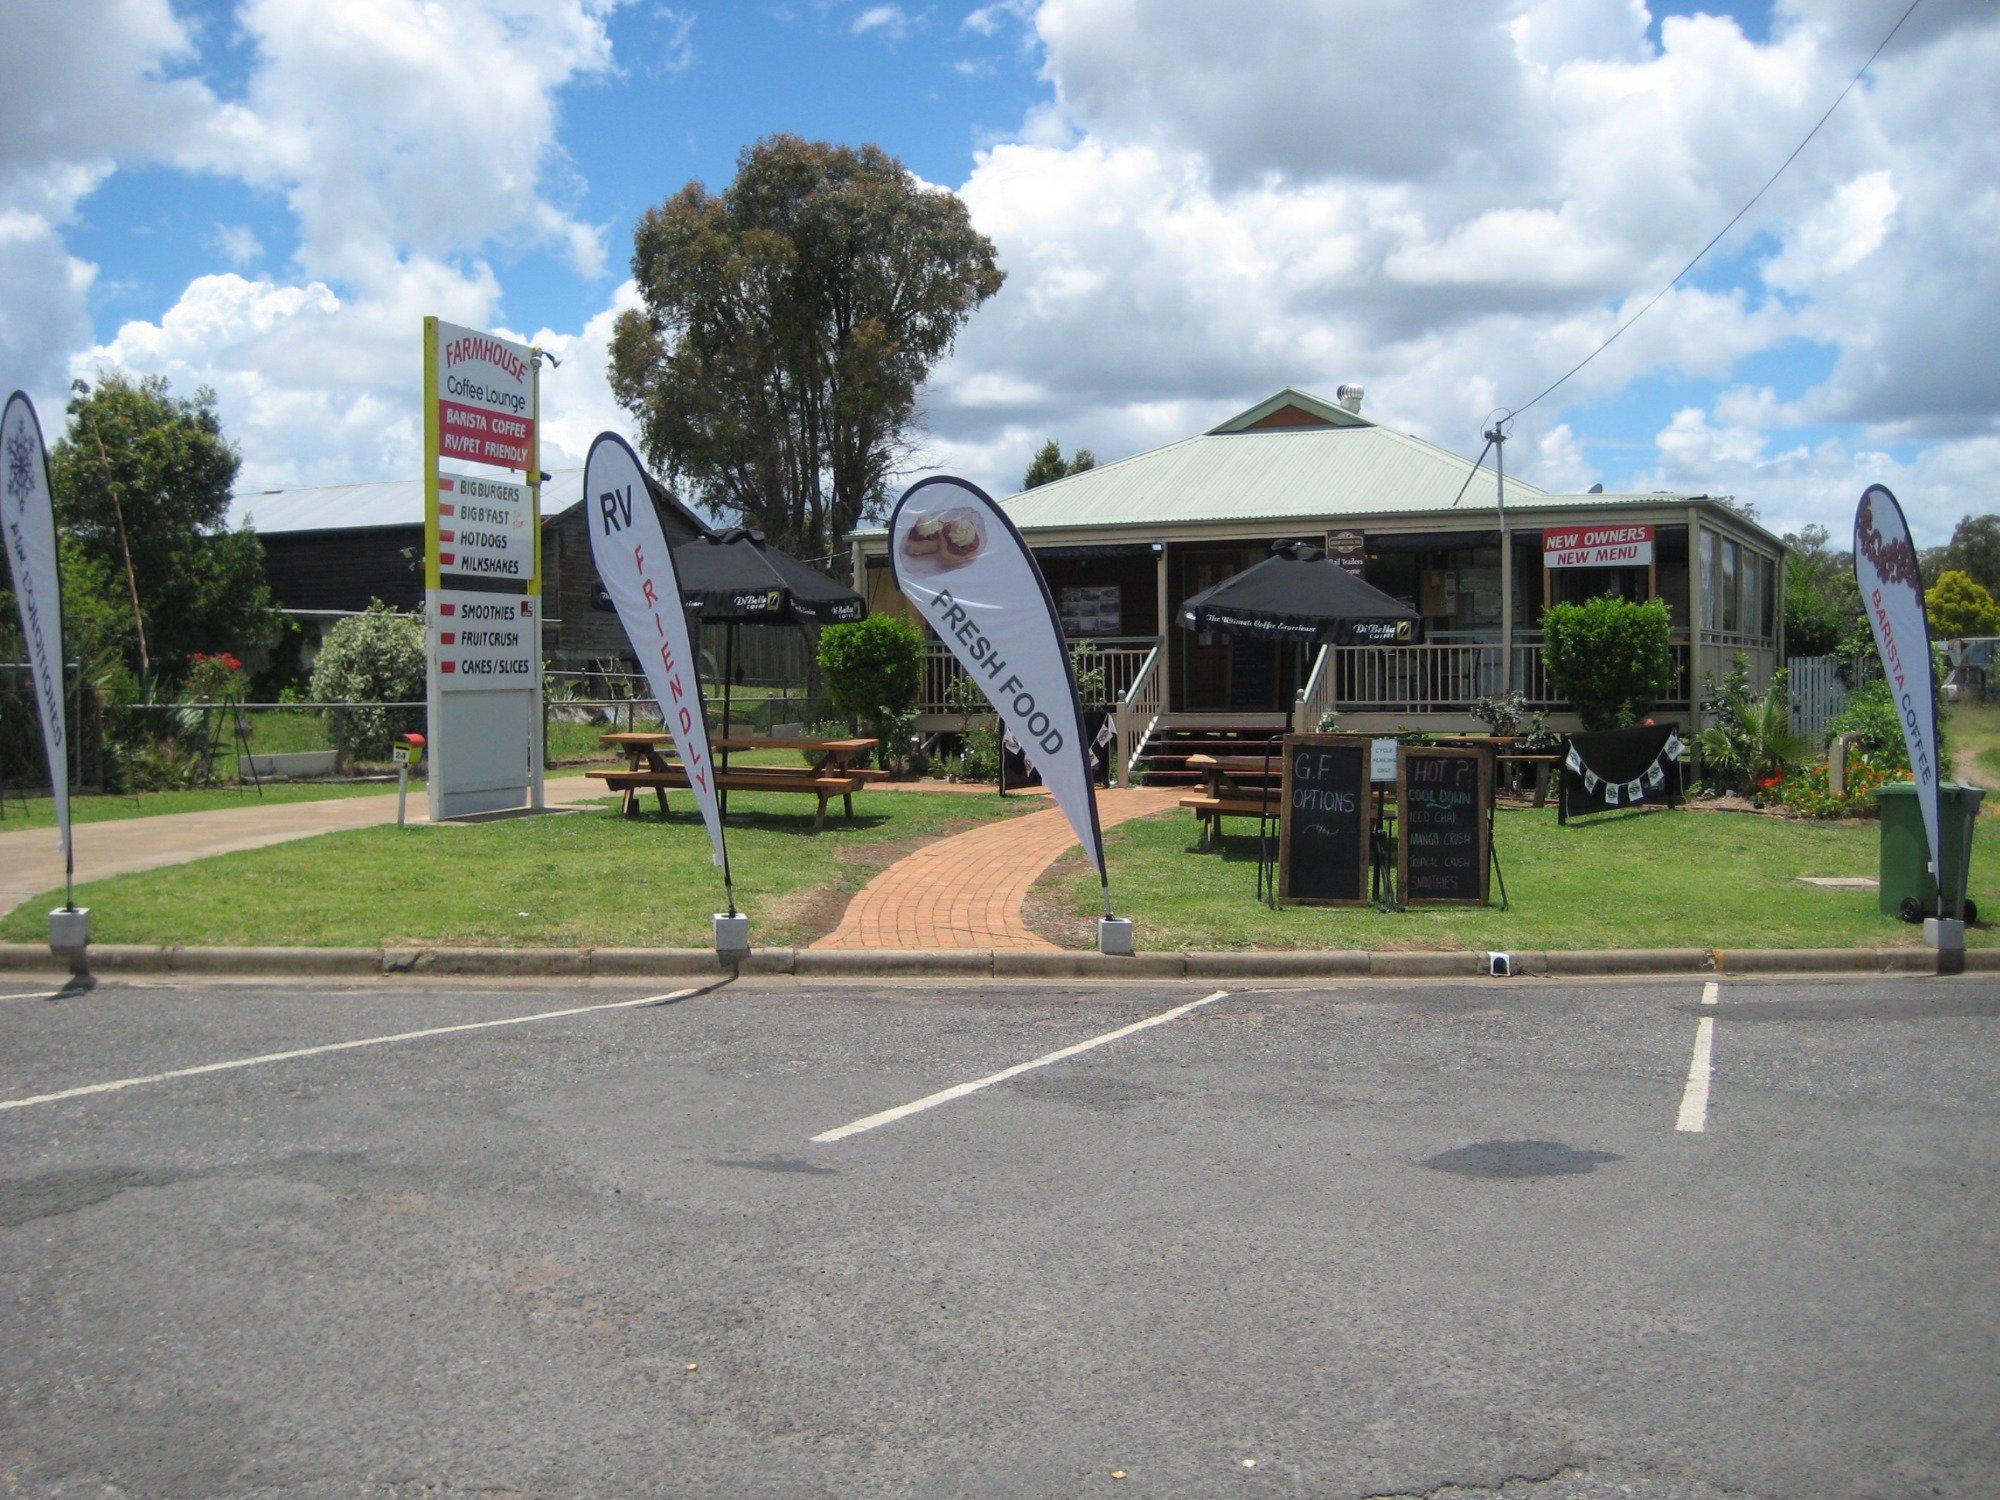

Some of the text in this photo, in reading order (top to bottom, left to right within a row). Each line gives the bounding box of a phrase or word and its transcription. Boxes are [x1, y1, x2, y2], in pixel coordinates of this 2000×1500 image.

[446, 337, 528, 384] FARMHOUSE
[447, 375, 525, 413] Coffee Lounge
[446, 408, 526, 438] BARISTA COFFEE
[445, 433, 528, 461] RV/PET FRIENDLY
[600, 484, 634, 536] RV
[1546, 526, 1646, 549] NEW OWNERS
[461, 556, 519, 574] MILKSHAKES
[1557, 545, 1638, 565] NEW MENU
[461, 604, 515, 620] SMOOTHIES
[930, 588, 1006, 679] FRESH
[1871, 588, 1906, 692] BARISTA
[634, 543, 708, 794] FRIENDLY
[998, 675, 1064, 755] FOOD
[1901, 693, 1932, 787] COFFEE
[395, 751, 406, 760] 24
[1415, 759, 1447, 781] HOT
[1293, 788, 1355, 812] OPTIONS
